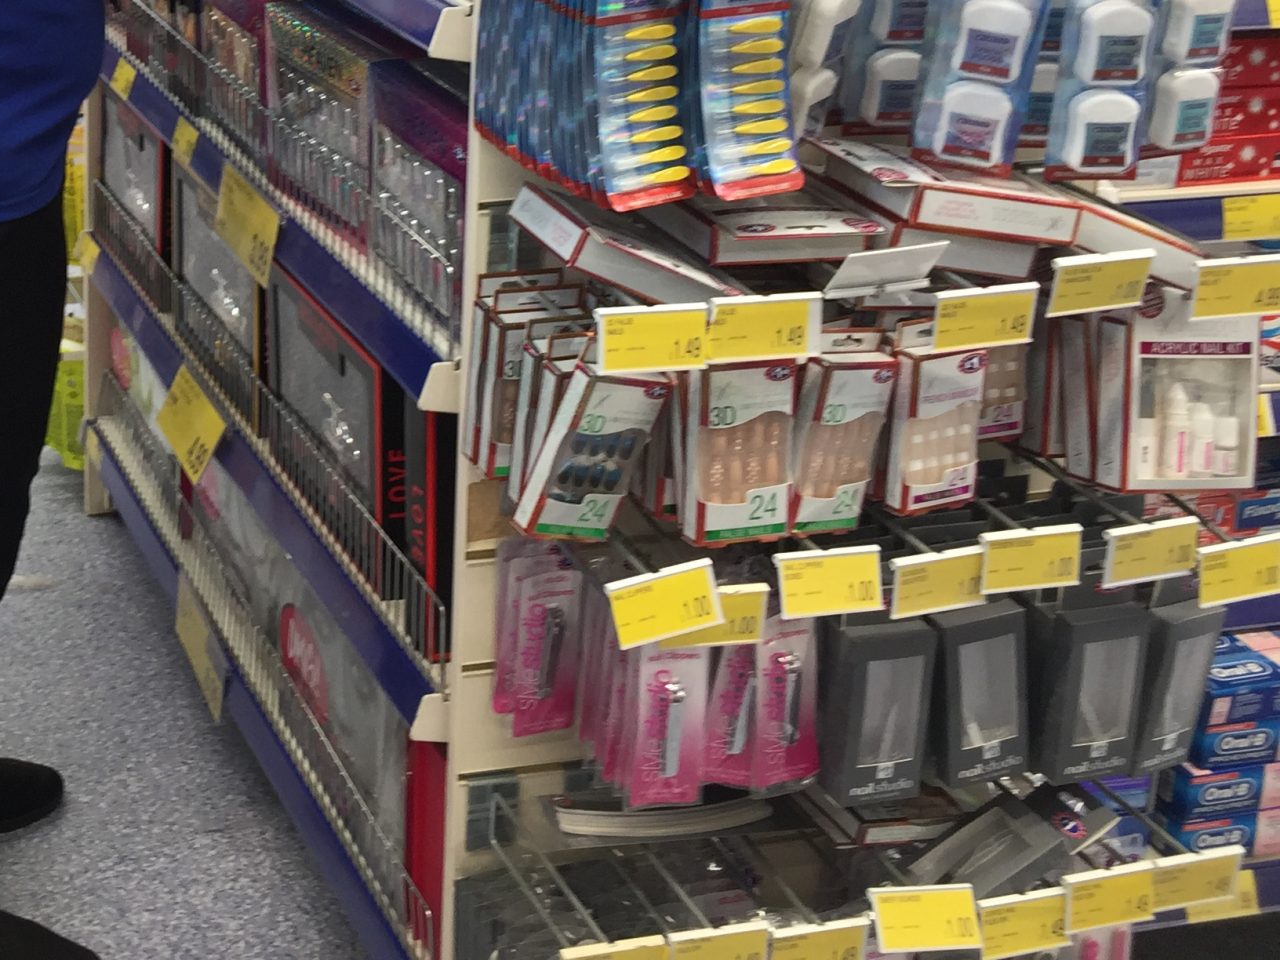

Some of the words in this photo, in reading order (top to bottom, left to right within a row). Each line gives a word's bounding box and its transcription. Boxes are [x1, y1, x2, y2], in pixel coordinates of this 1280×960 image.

[1150, 342, 1199, 354] ACRYLIC
[710, 406, 737, 427] 3D
[993, 405, 1016, 423] 24
[578, 500, 610, 522] 24
[749, 493, 777, 521] 24
[832, 489, 859, 515] 24
[1210, 660, 1265, 678] Oral-B
[1220, 732, 1267, 750] Oral-B
[1205, 782, 1251, 800] Oral-B
[1196, 829, 1243, 848] Oral-B
